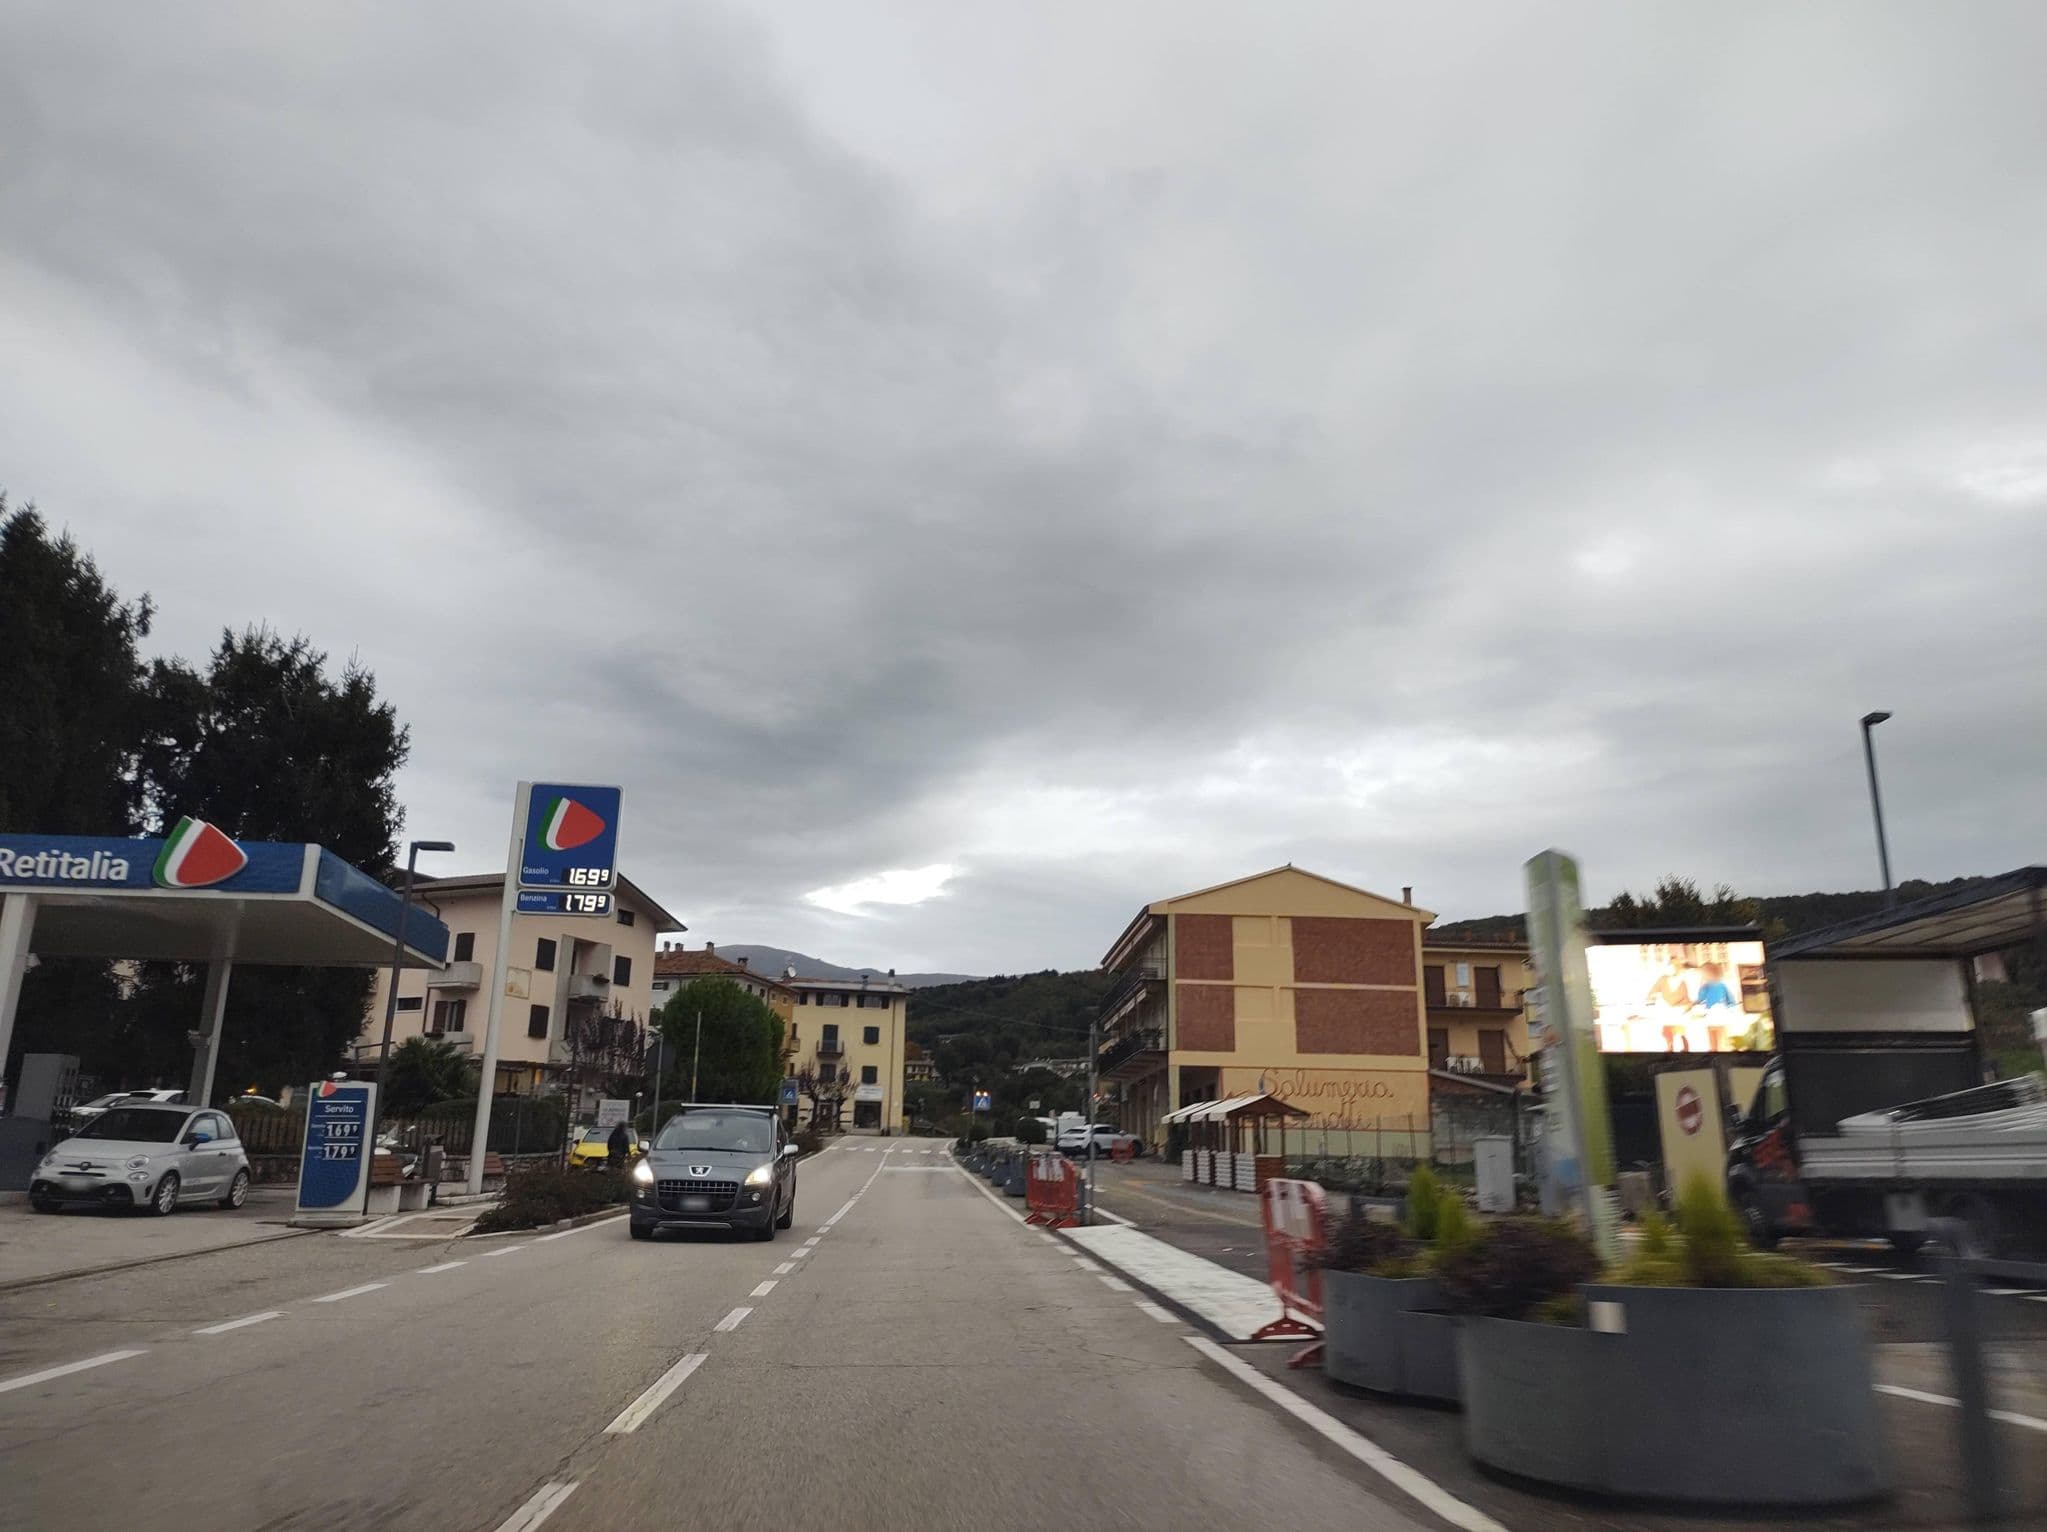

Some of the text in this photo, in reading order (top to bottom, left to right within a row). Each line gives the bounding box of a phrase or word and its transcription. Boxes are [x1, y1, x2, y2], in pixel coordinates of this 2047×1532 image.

[0, 848, 129, 880] Retitalia
[522, 867, 549, 875] Gasolio
[520, 894, 547, 902] Benzina
[325, 1104, 354, 1113] Servito
